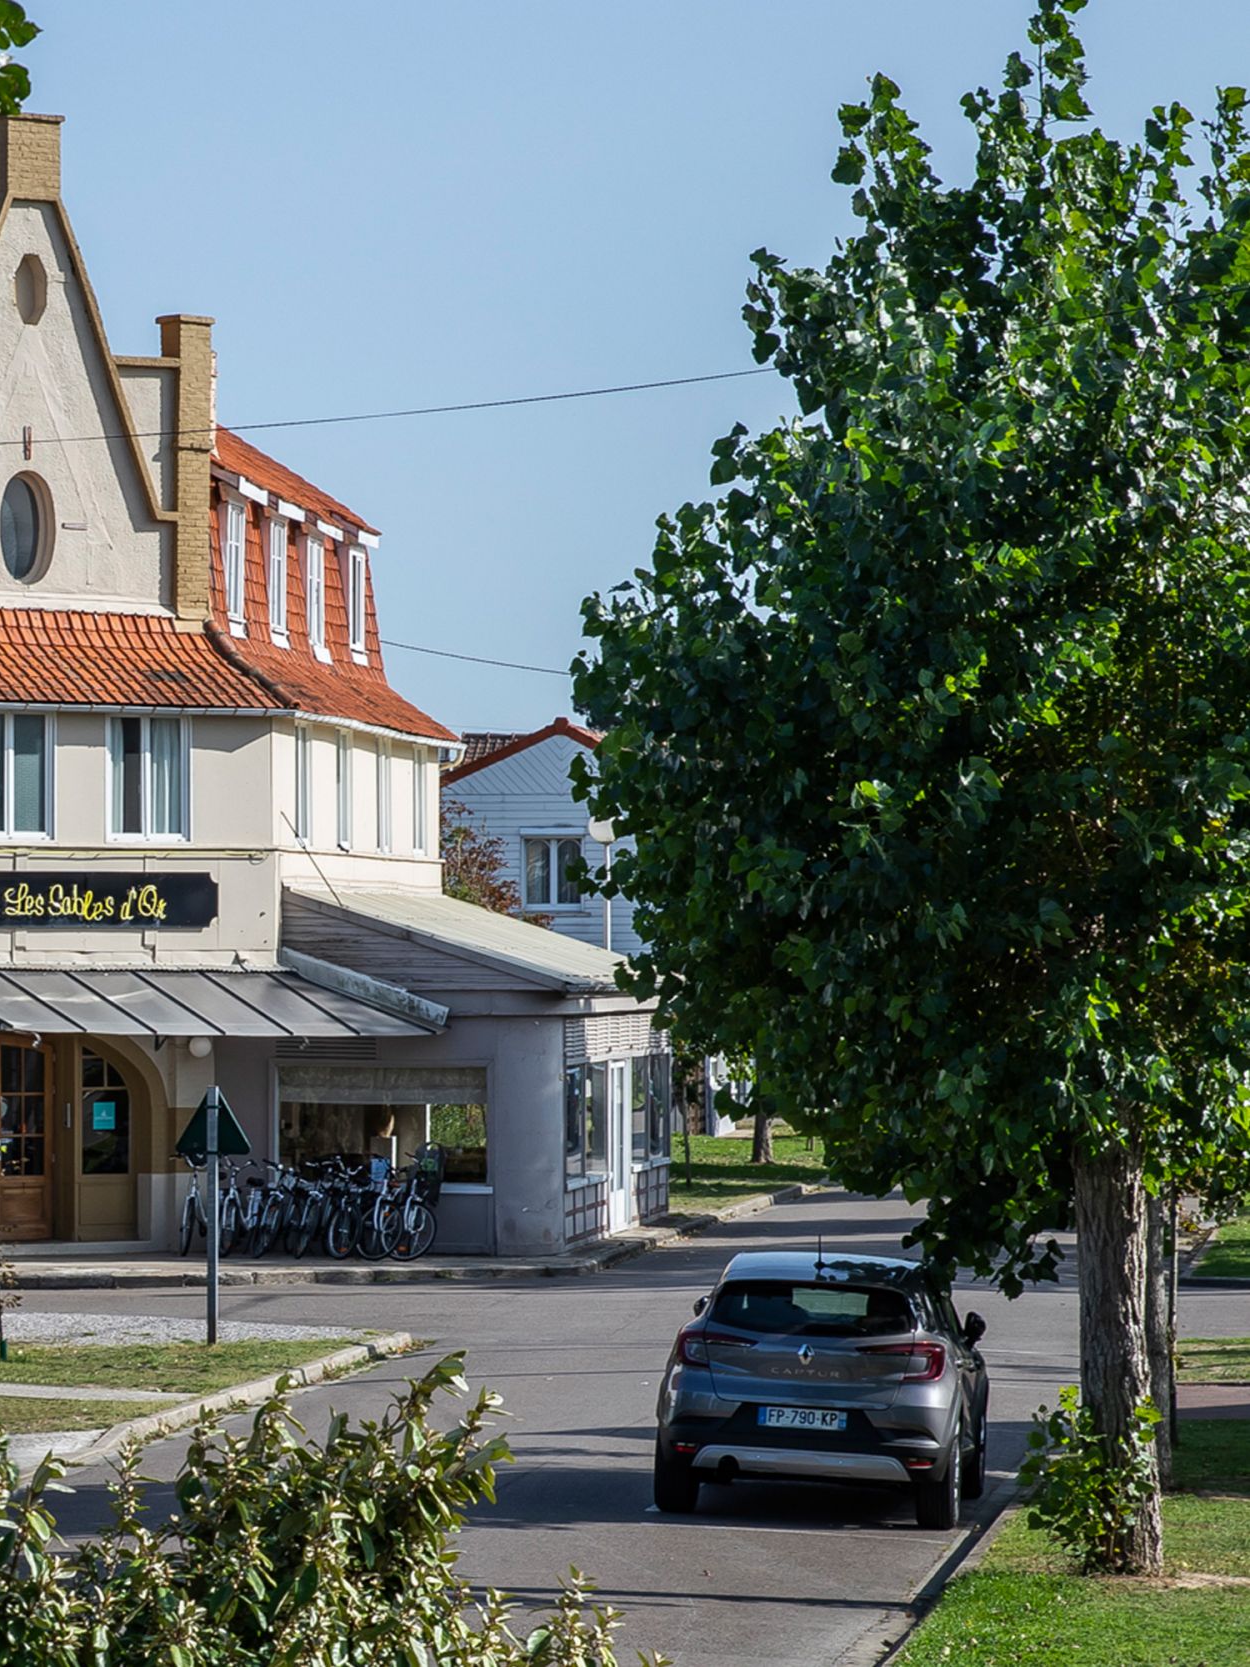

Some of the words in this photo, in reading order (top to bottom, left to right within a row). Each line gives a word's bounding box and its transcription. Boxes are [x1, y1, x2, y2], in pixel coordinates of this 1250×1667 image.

[4, 883, 44, 916] Les
[48, 884, 114, 921] Sables
[121, 885, 166, 920] d'Or
[770, 1367, 840, 1378] CAPTUR
[768, 1408, 838, 1426] FP-790-KP
